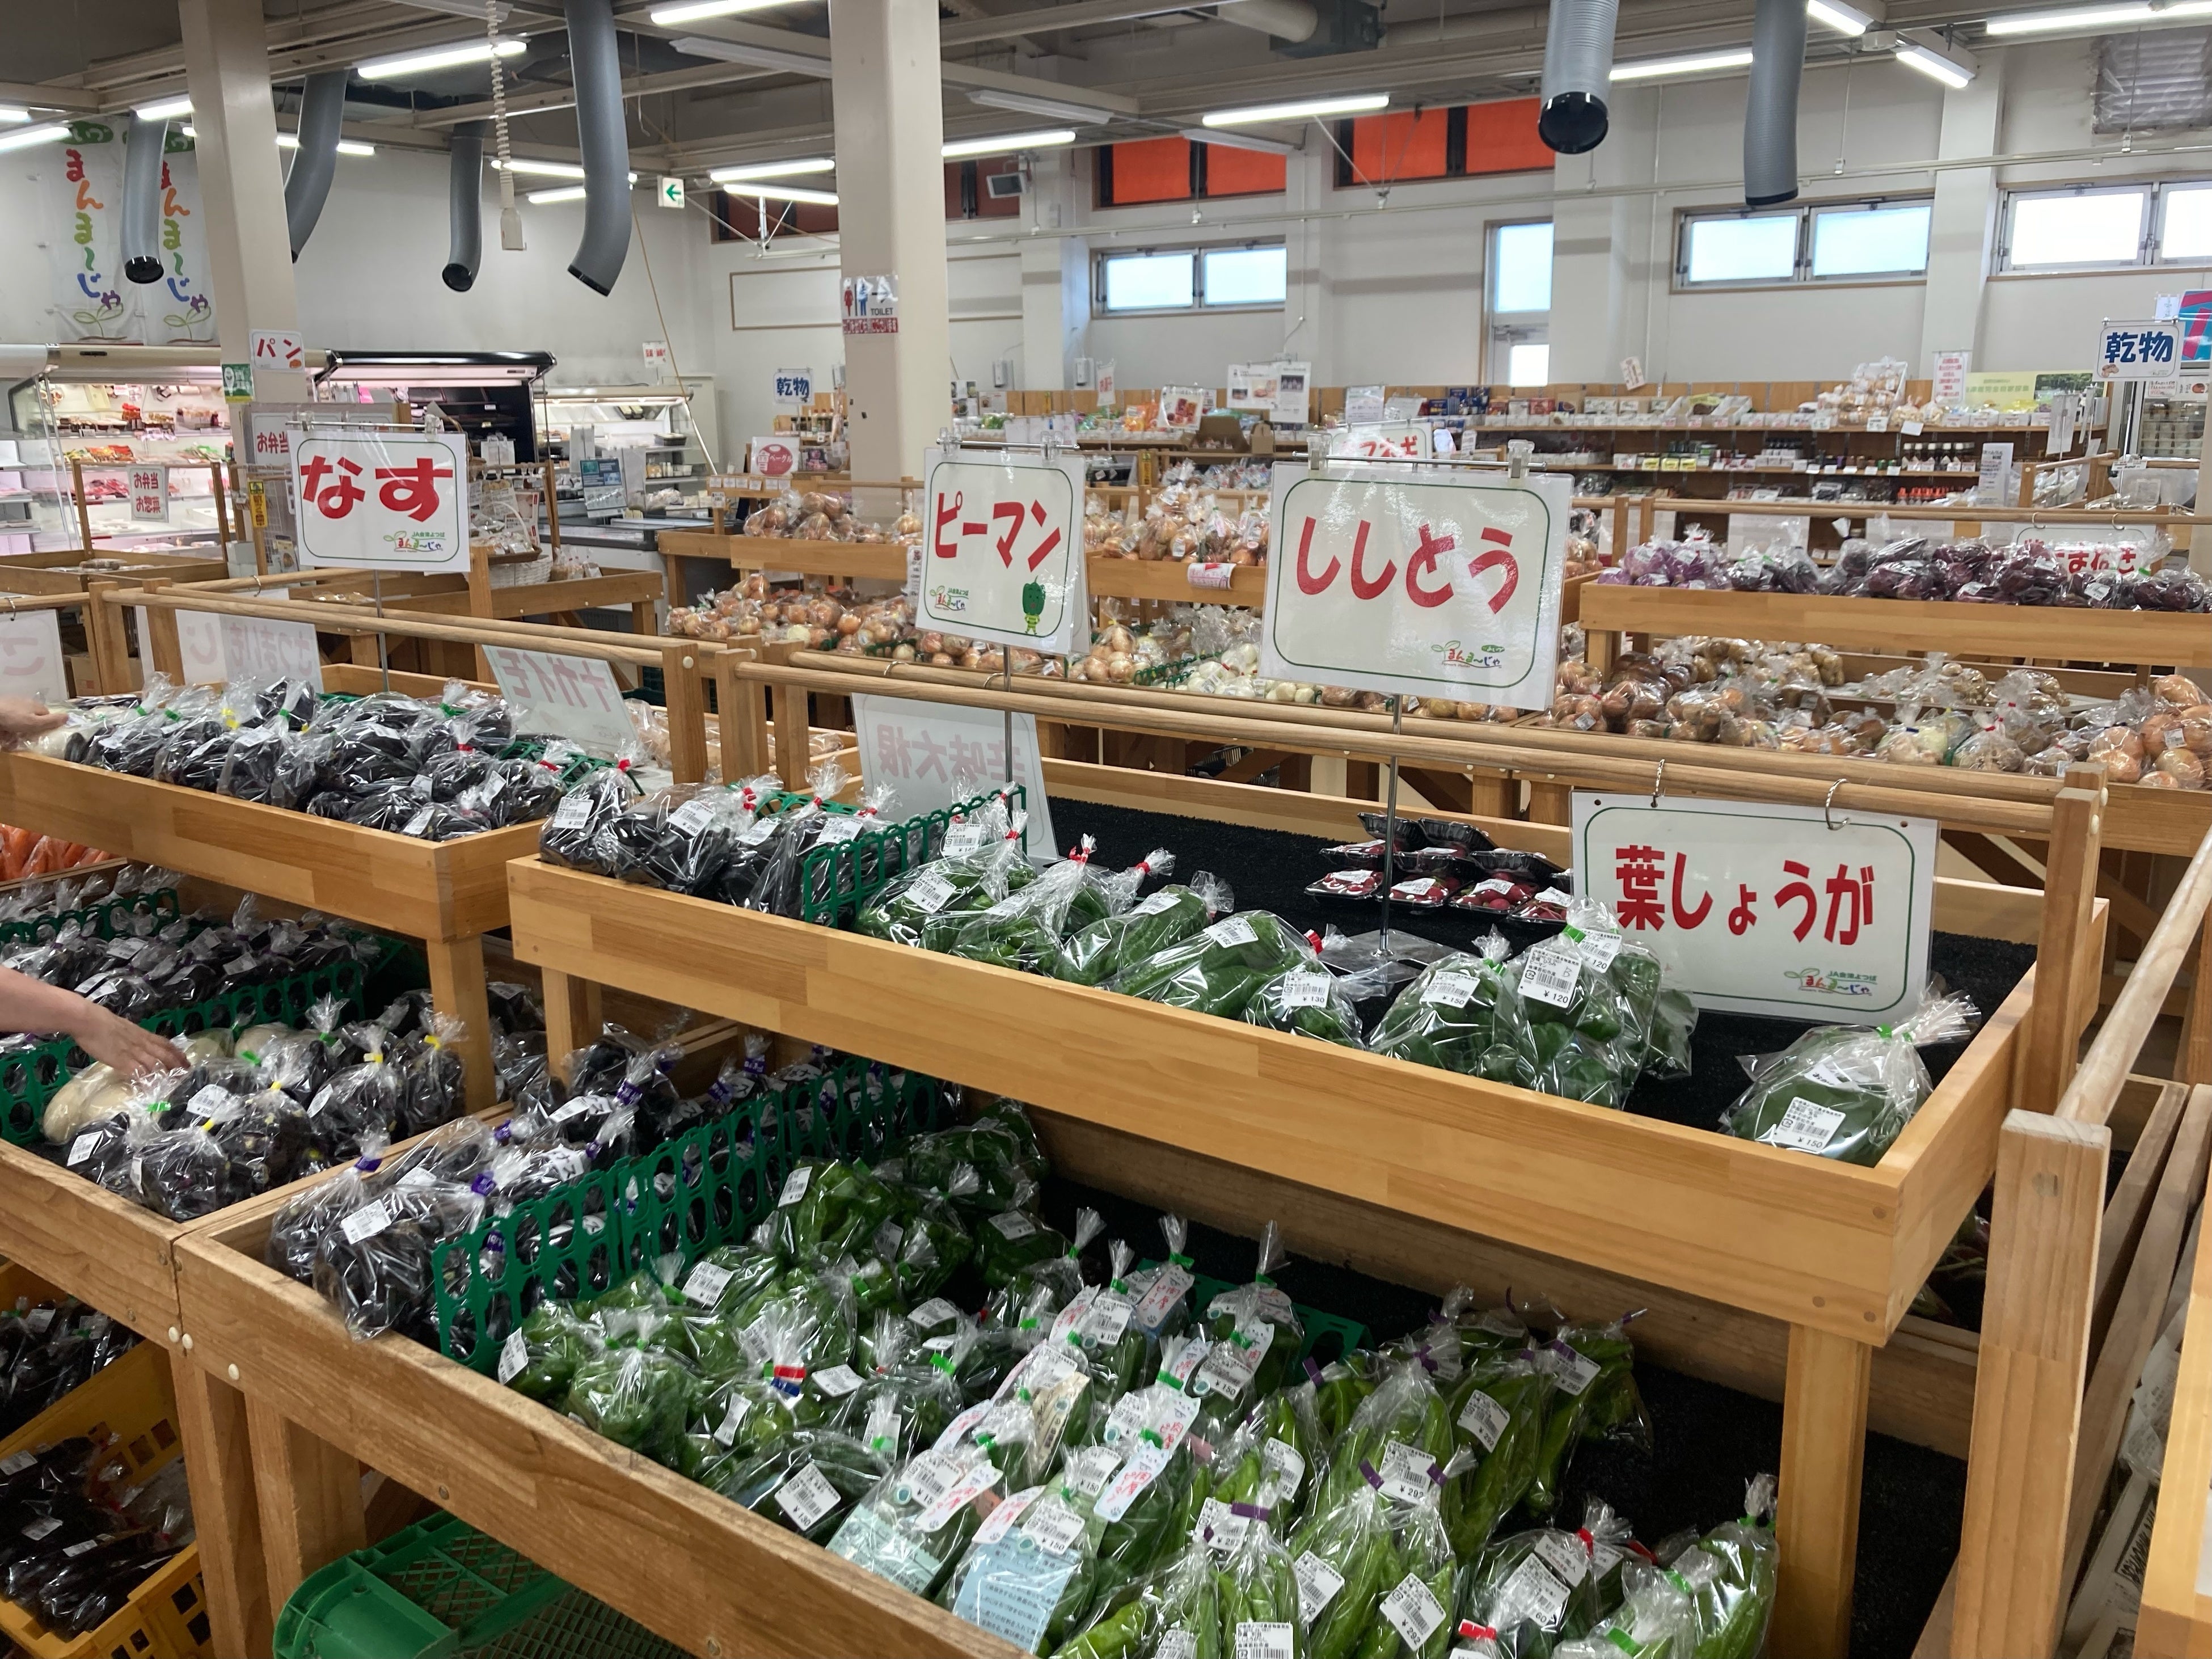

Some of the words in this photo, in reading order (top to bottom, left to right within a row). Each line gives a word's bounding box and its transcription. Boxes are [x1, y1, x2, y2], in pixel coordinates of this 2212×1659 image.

[257, 337, 301, 359] パン
[2104, 331, 2174, 364] 乾物
[776, 377, 810, 396] 乾物
[257, 430, 289, 454] お弁当
[769, 454, 793, 463] ベーグル
[133, 471, 159, 490] お弁当
[300, 455, 454, 522] なす
[935, 491, 1062, 573] ピーマン
[1296, 516, 1519, 615] ししとう
[1615, 844, 1875, 946] 葉しょうが
[1593, 959, 1608, 970] 120
[1562, 966, 1573, 978] B
[1552, 993, 1569, 1004] 120
[1806, 1139, 1823, 1149] 150
[1106, 1333, 1118, 1343] 150
[1222, 1383, 1236, 1395] 150
[1483, 1434, 1495, 1448] 292
[1086, 1480, 1099, 1492] 150
[1407, 1488, 1424, 1498] 292
[798, 1512, 812, 1526] 130
[1048, 1539, 1065, 1551] 150
[1407, 1628, 1421, 1644] 292
